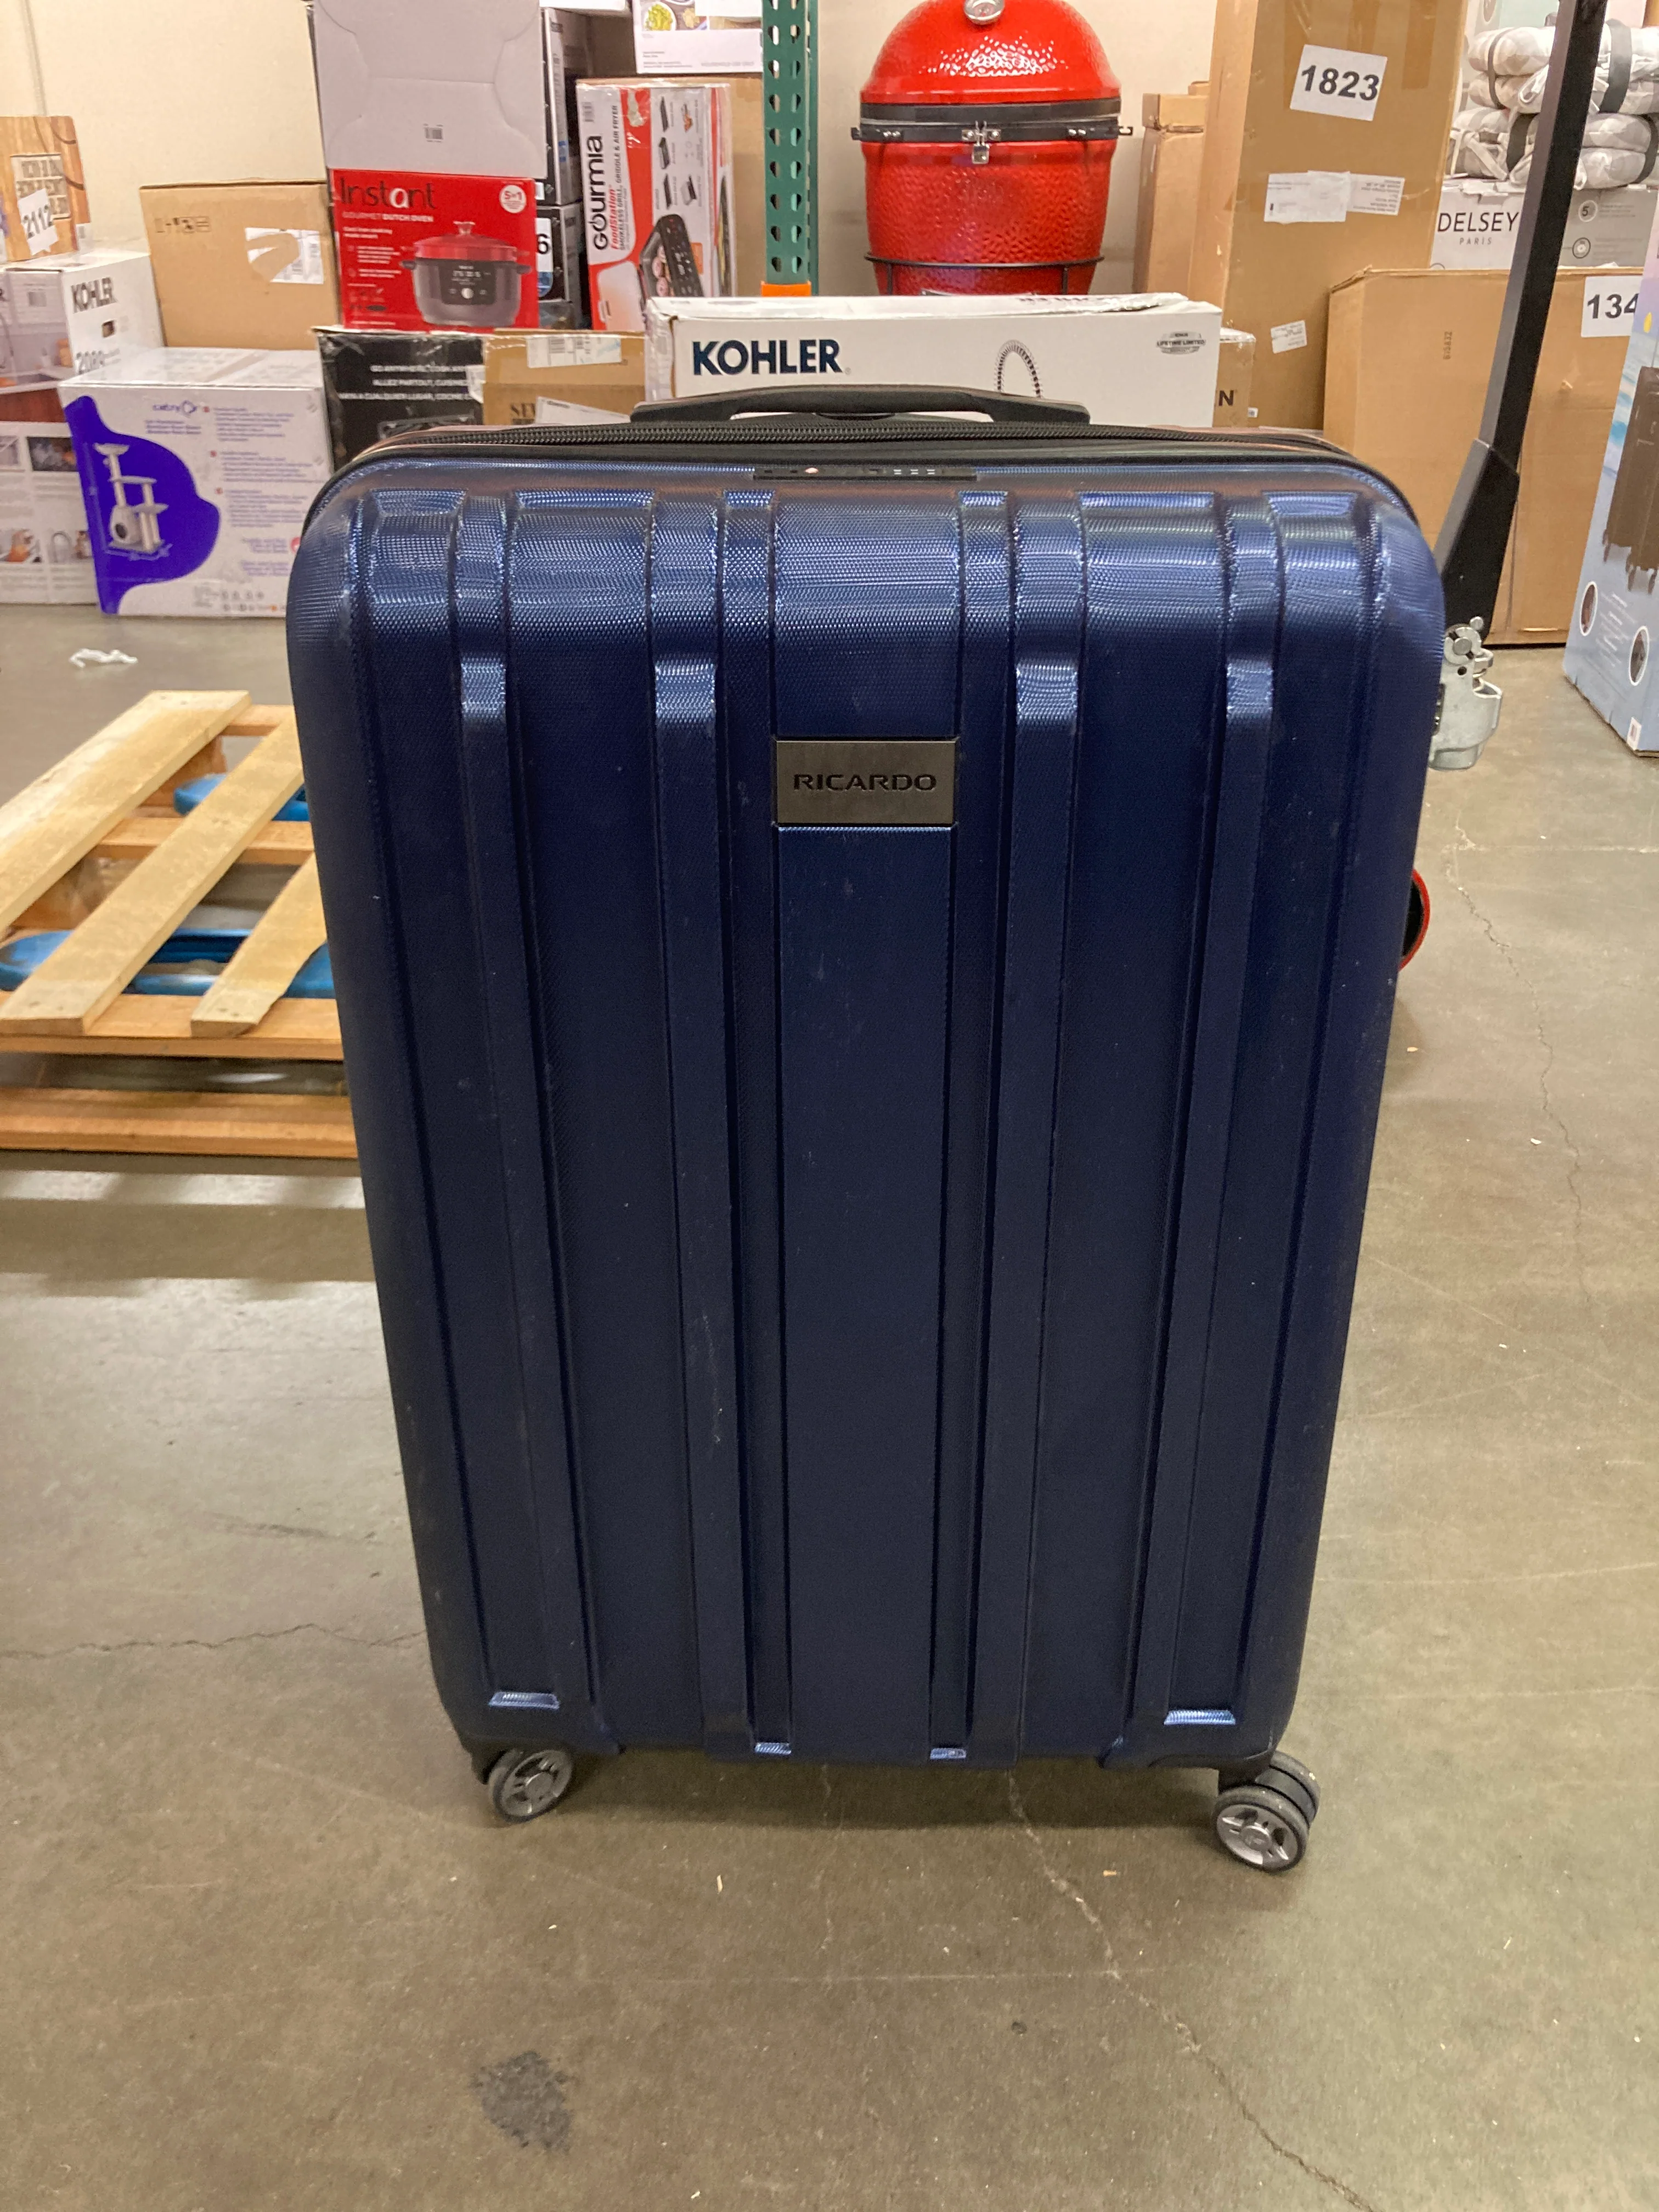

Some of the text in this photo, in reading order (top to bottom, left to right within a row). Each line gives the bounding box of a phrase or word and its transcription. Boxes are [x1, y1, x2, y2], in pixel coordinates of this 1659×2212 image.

[1301, 65, 1379, 101] 1823
[340, 177, 436, 210] Instant
[587, 136, 608, 251] Gourmia
[1437, 212, 1519, 232] DELSEY
[1459, 237, 1492, 245] PARIS
[692, 339, 843, 375] KOHLER
[793, 774, 936, 791] RICARDO
